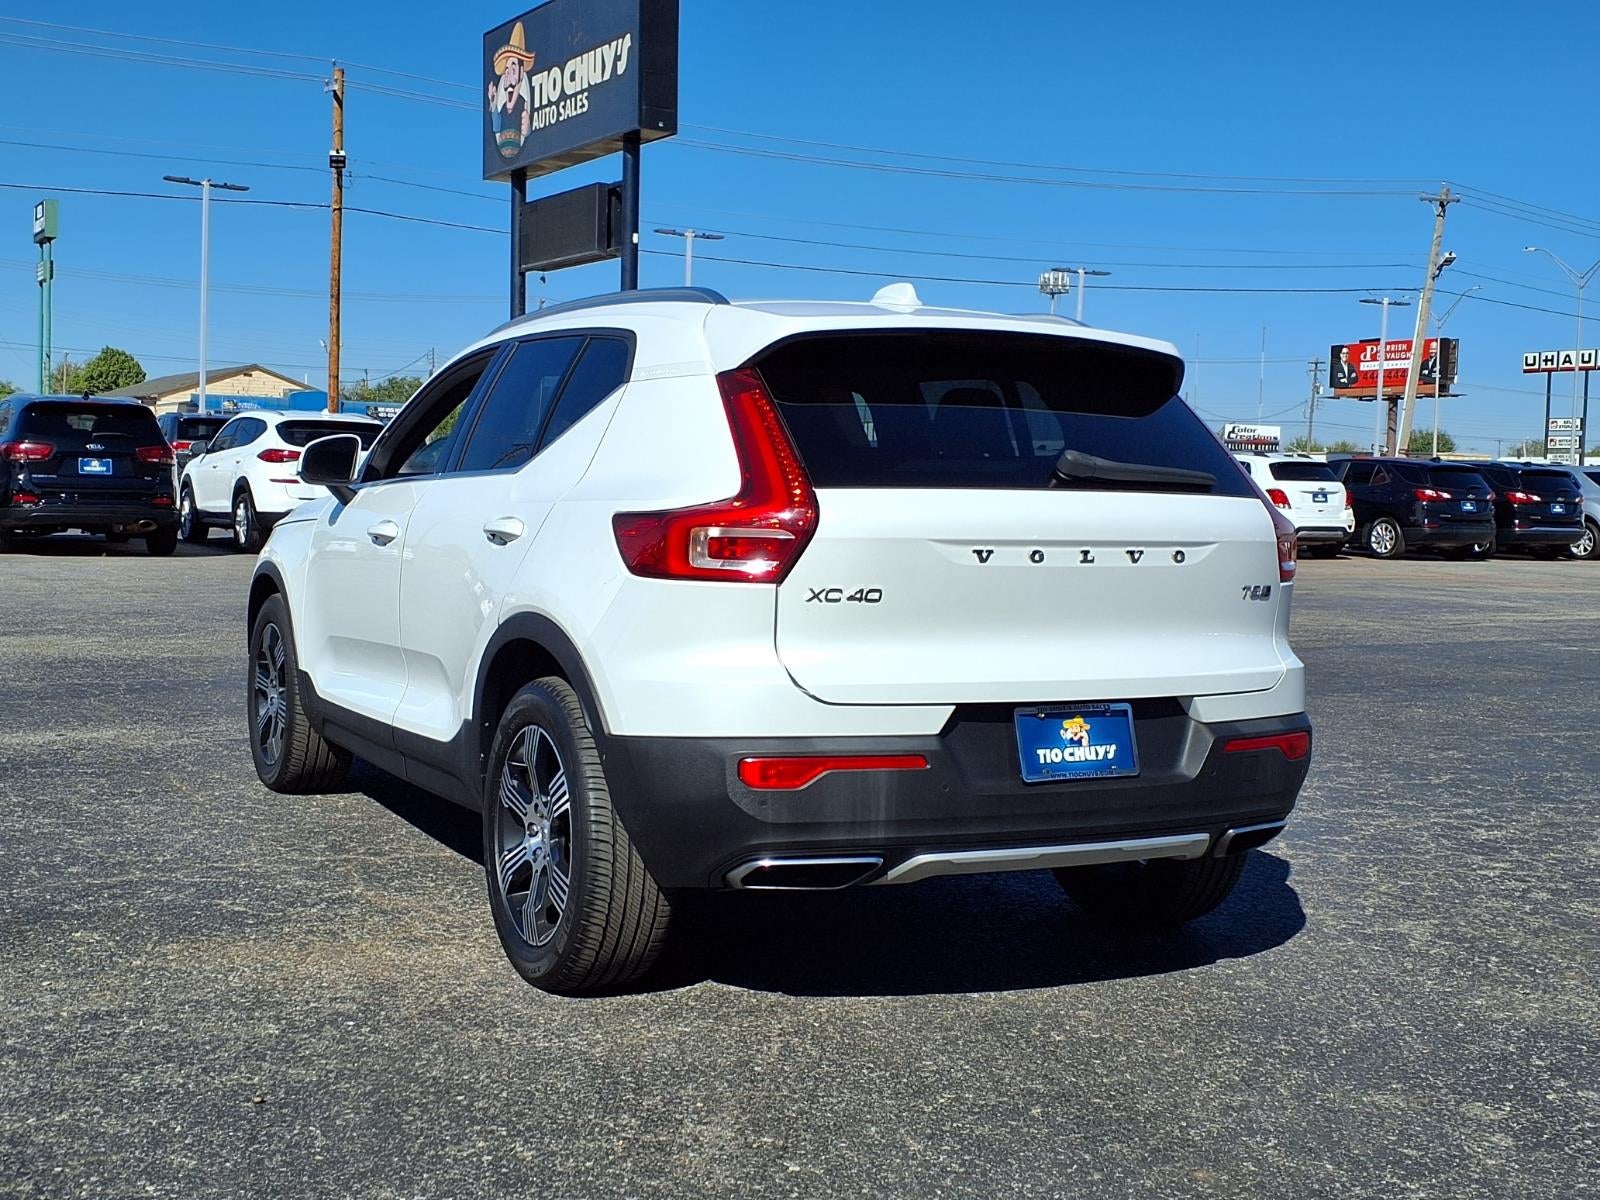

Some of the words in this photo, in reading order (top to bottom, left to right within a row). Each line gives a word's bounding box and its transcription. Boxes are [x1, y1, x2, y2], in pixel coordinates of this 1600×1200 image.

[532, 66, 561, 108] TIO
[563, 33, 631, 95] CHUY'S
[532, 104, 557, 130] AUTO
[559, 92, 589, 121] SALES
[1377, 344, 1408, 352] PRRISH
[1376, 351, 1412, 361] DVAUGH
[1227, 430, 1278, 441] Creations
[1231, 425, 1258, 435] Color
[972, 547, 1187, 565] VOLVO
[1036, 748, 1063, 764] TIO
[1063, 743, 1117, 762] CHUY'S
